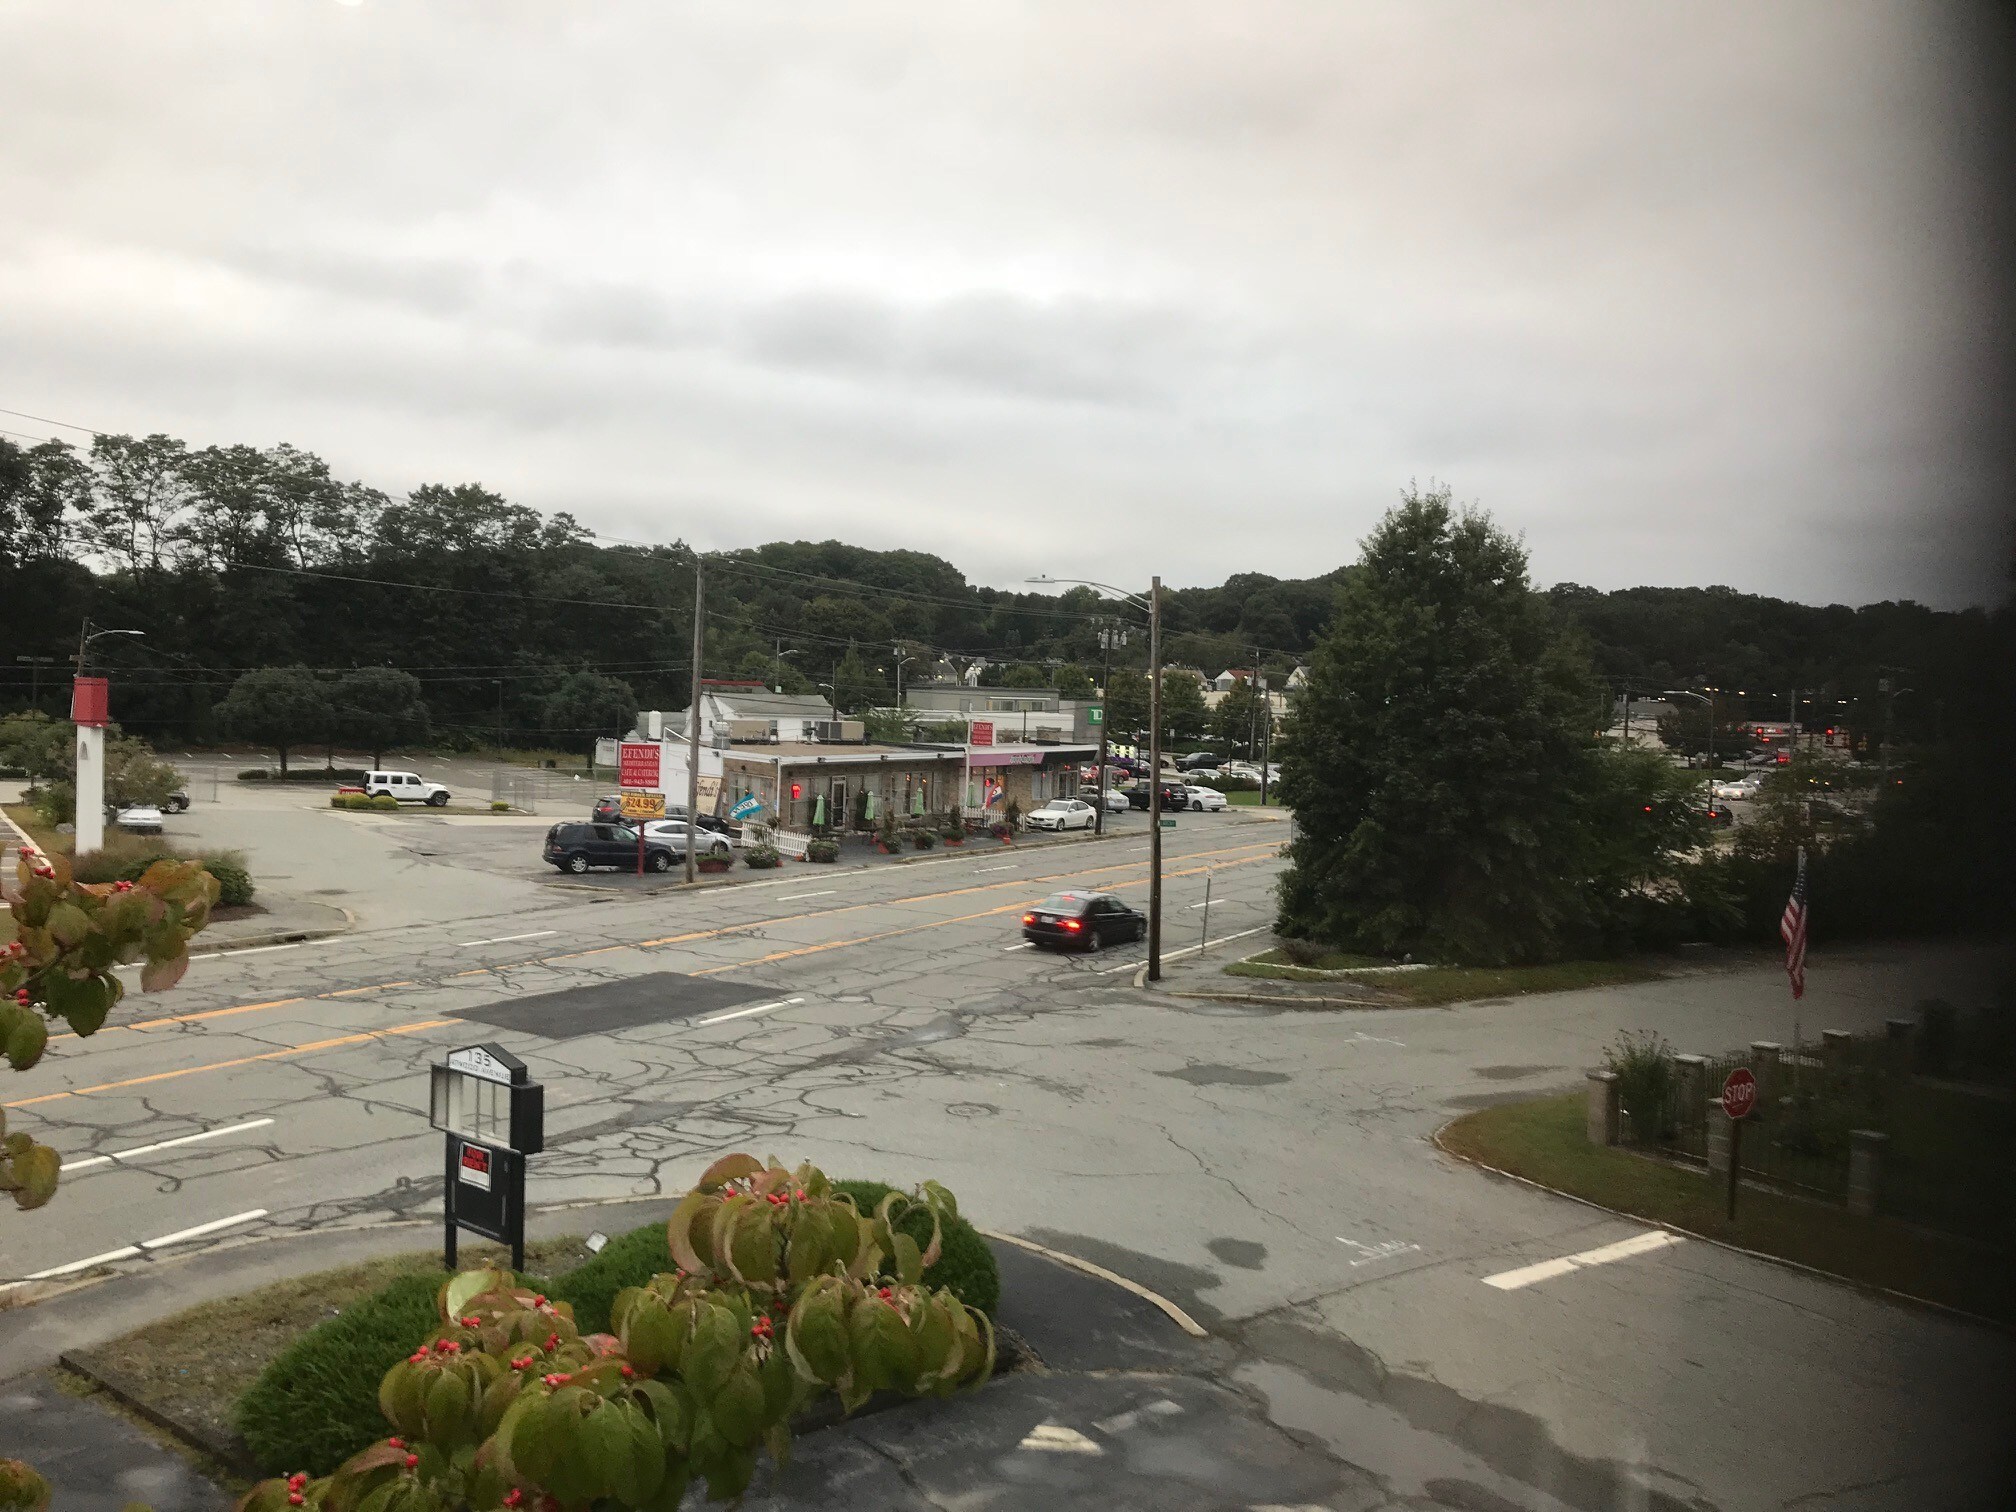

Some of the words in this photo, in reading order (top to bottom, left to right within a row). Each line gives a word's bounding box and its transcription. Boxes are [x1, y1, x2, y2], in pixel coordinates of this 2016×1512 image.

[1091, 709, 1103, 720] TD
[622, 748, 659, 760] EFENDI'S
[626, 797, 656, 809] $24.99
[467, 1050, 491, 1067] 135
[1724, 1082, 1754, 1104] STOP
[466, 1146, 484, 1161] FOR
